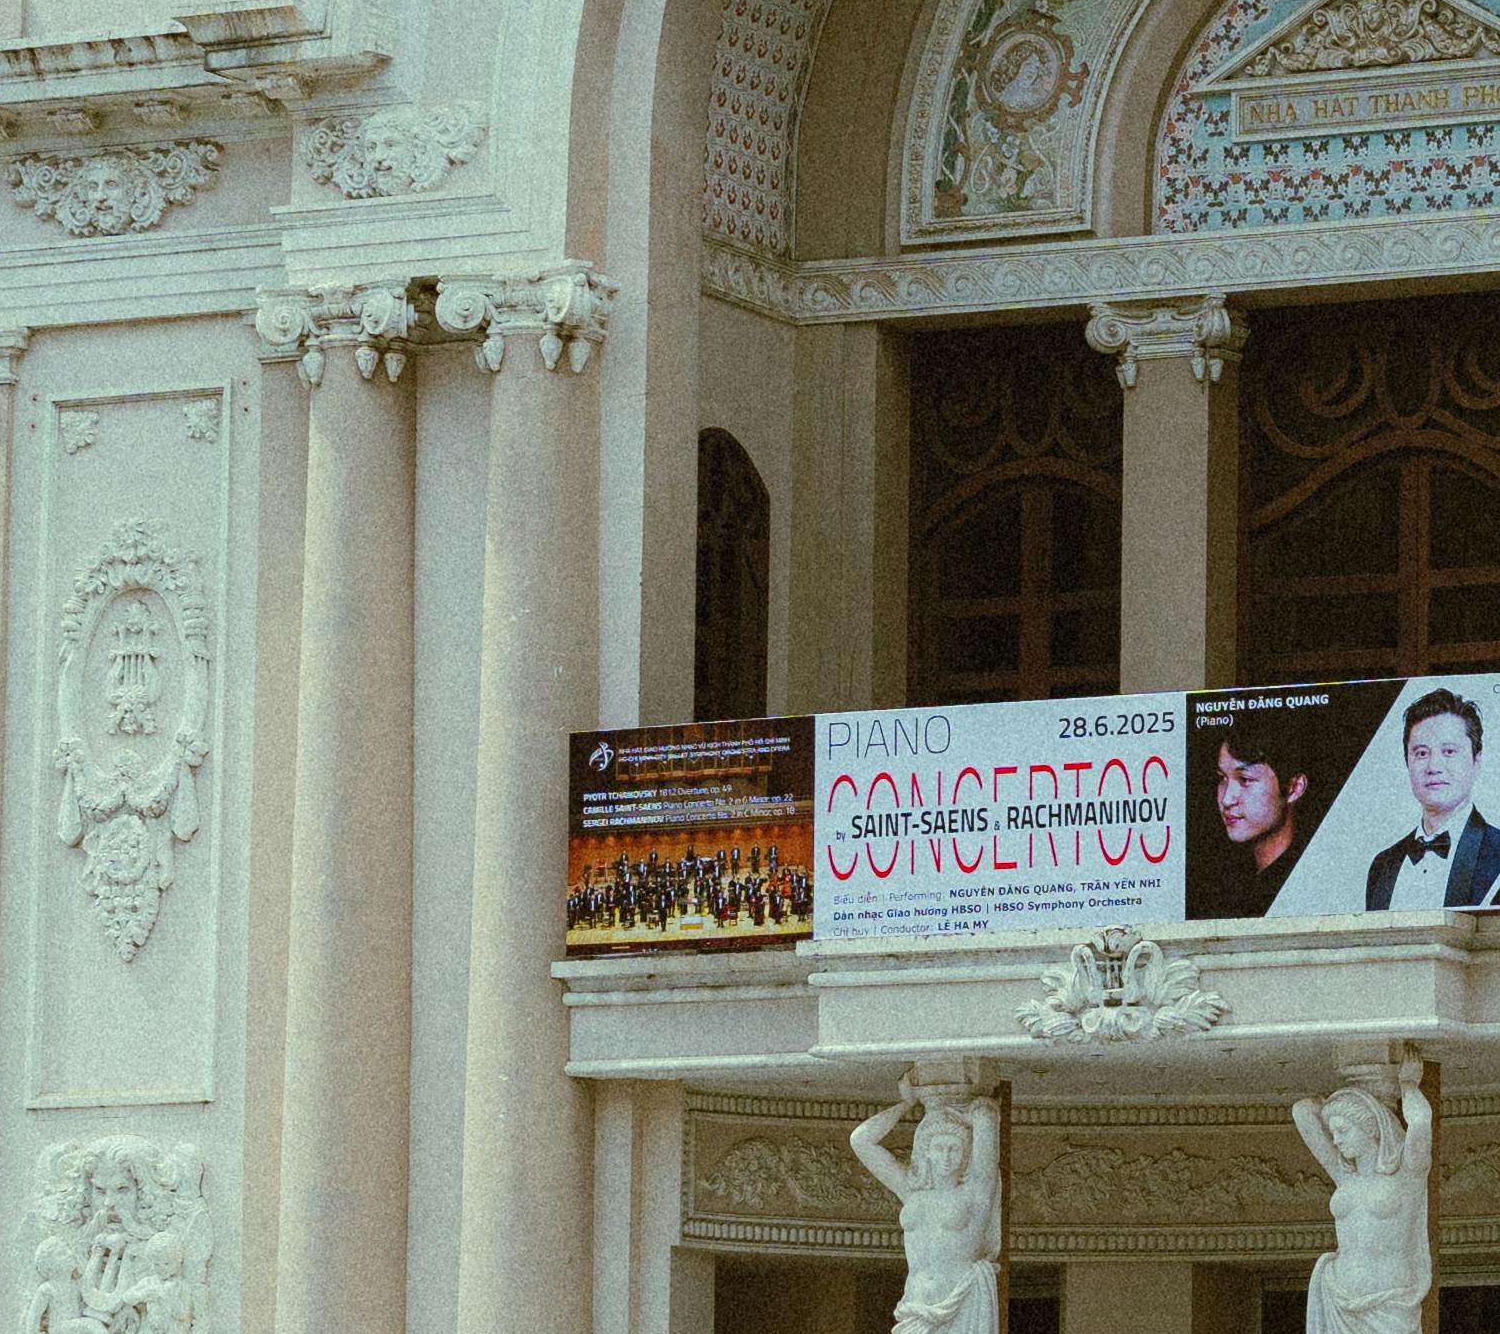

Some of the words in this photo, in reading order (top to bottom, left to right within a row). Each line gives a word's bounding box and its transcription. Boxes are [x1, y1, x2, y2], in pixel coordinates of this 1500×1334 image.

[1285, 693, 1329, 708] QUANG
[1195, 714, 1234, 729] (Piano)
[828, 714, 952, 761] PIANO
[1059, 712, 1175, 740] 28.6.2025
[827, 755, 1170, 881] CONCERTOS
[851, 807, 988, 839] SAINT-SAENS
[1007, 797, 1167, 830] RACHMANINOV
[1033, 882, 1077, 895] QUANG,
[1139, 878, 1161, 888] NHI
[886, 906, 911, 919] Giao
[951, 904, 981, 916] HBSO
[993, 901, 1023, 912] HBSO
[1028, 897, 1085, 913] Symphony
[1088, 895, 1142, 908] Orchestra
[972, 918, 989, 930] MY
